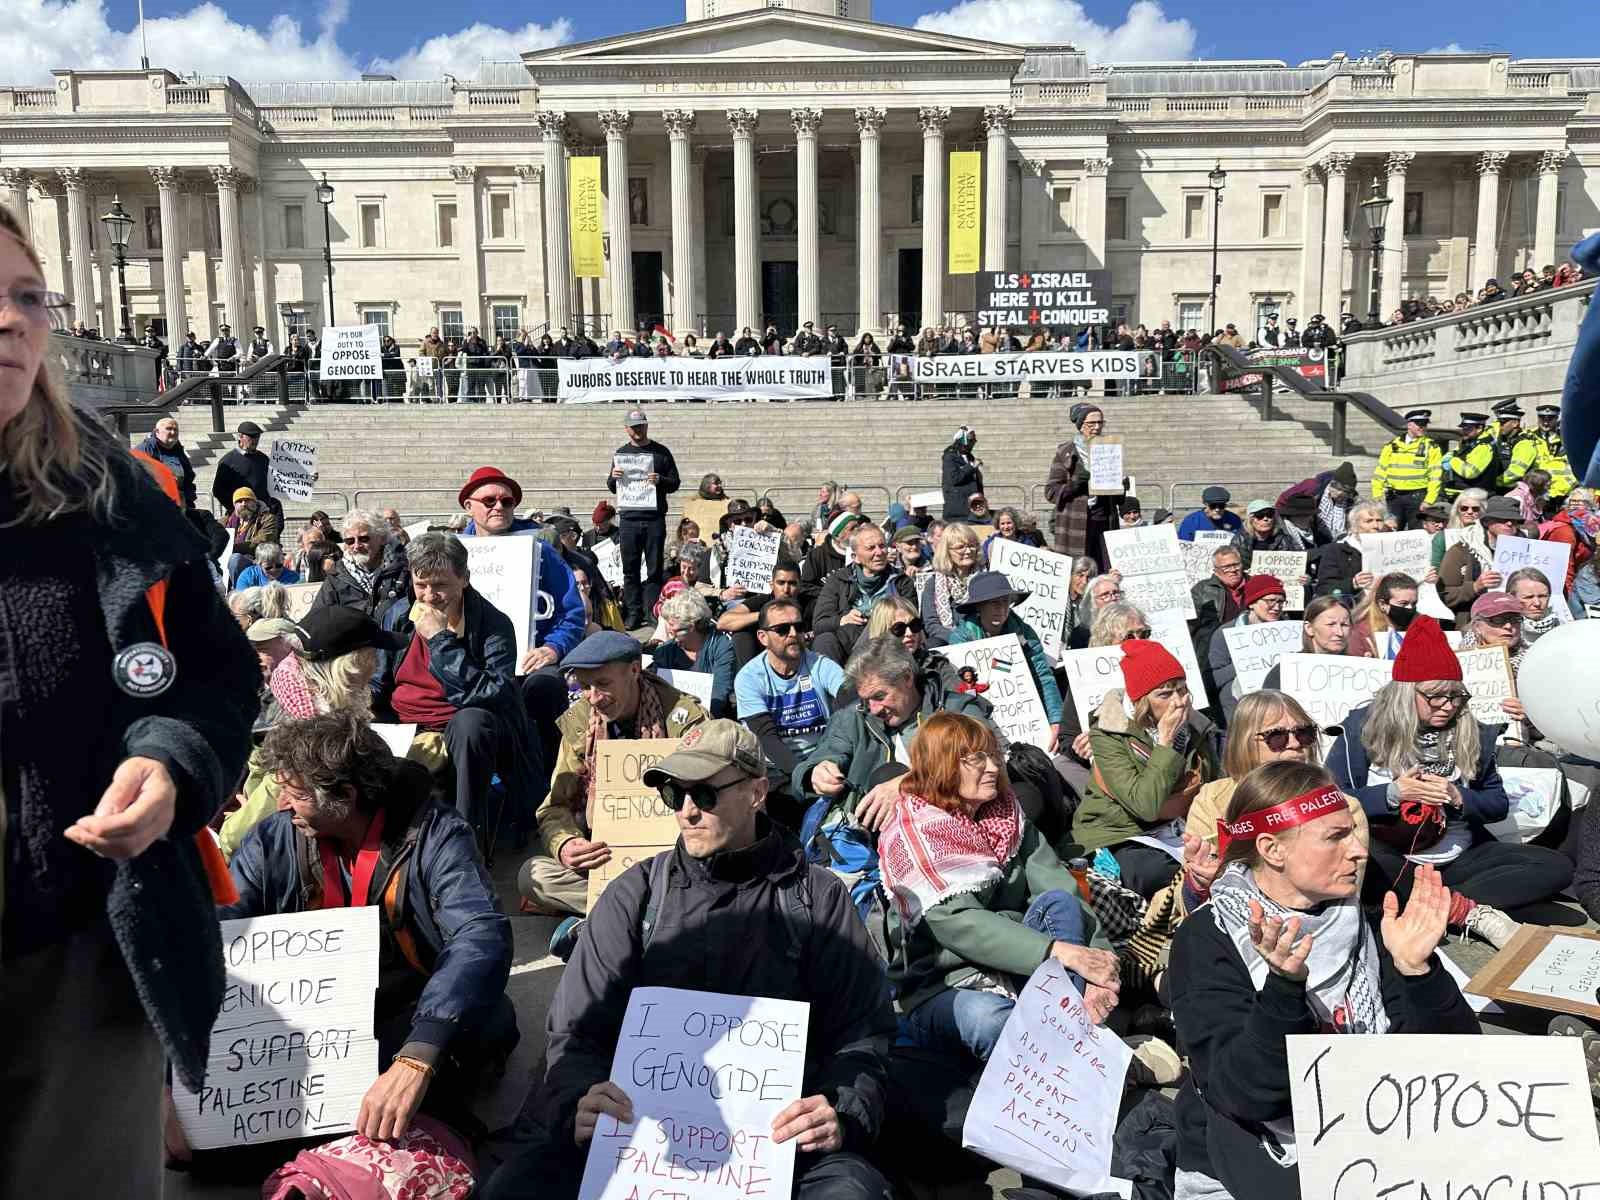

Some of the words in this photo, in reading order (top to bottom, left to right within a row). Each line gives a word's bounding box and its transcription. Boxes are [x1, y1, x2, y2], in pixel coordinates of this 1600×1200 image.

[641, 80, 680, 93] THE
[694, 80, 800, 93] NATIONAL
[815, 79, 904, 92] GALLERY
[966, 173, 976, 230] GALLERY
[1031, 273, 1092, 288] ISRAEL
[990, 292, 1029, 307] HERE
[1032, 292, 1053, 307] TO
[1056, 291, 1097, 306] KILL
[978, 310, 1028, 326] STEAL
[1041, 308, 1109, 325] CONQUER
[333, 350, 370, 360] OPPOSE
[328, 365, 376, 376] GENOCIDE
[917, 361, 988, 377] ISRAEL
[994, 359, 1084, 375] STARVES
[1091, 357, 1137, 373] KIDS
[567, 371, 612, 388] JURORS
[615, 370, 666, 387] DESERVE
[670, 370, 684, 385] TO
[687, 370, 717, 386] HEAR
[721, 371, 742, 385] THE
[746, 370, 784, 385] WHOLE
[788, 369, 825, 385] TRUTH
[738, 539, 776, 554] GENOCIDE
[740, 559, 774, 571] SUPPORT
[1009, 551, 1065, 577] OPPOSE
[1265, 555, 1304, 566] OPPOSE
[1499, 550, 1549, 566] OPPOSE
[733, 568, 772, 583] PALESTINE
[1010, 574, 1061, 600] NOCIDE
[1024, 606, 1064, 632] PPORT
[1231, 633, 1249, 650] I
[1252, 627, 1300, 646] OPPOS
[989, 674, 1027, 698] CIDE
[785, 711, 811, 721] POLICE
[992, 699, 1034, 718] PPORT
[1000, 720, 1041, 737] STINE
[602, 754, 611, 783] I
[622, 753, 665, 783] OPP
[1265, 806, 1297, 826] FREE
[229, 929, 345, 967] OPPOSE
[1035, 974, 1058, 995] I
[222, 977, 337, 1013] ENICIDE
[629, 1003, 660, 1038] I
[683, 1011, 802, 1053] OPPOSE
[226, 1028, 358, 1072] SUPPORT
[632, 1048, 793, 1100] GENOCIDE
[1052, 1064, 1070, 1084] I
[199, 1074, 325, 1117] PALESTINE
[1303, 1046, 1345, 1147] I
[1366, 1073, 1570, 1142] OPPOSE
[233, 1103, 325, 1143] ACTION
[656, 1117, 769, 1160] SUPPORT
[616, 1147, 772, 1196] PALESTINE
